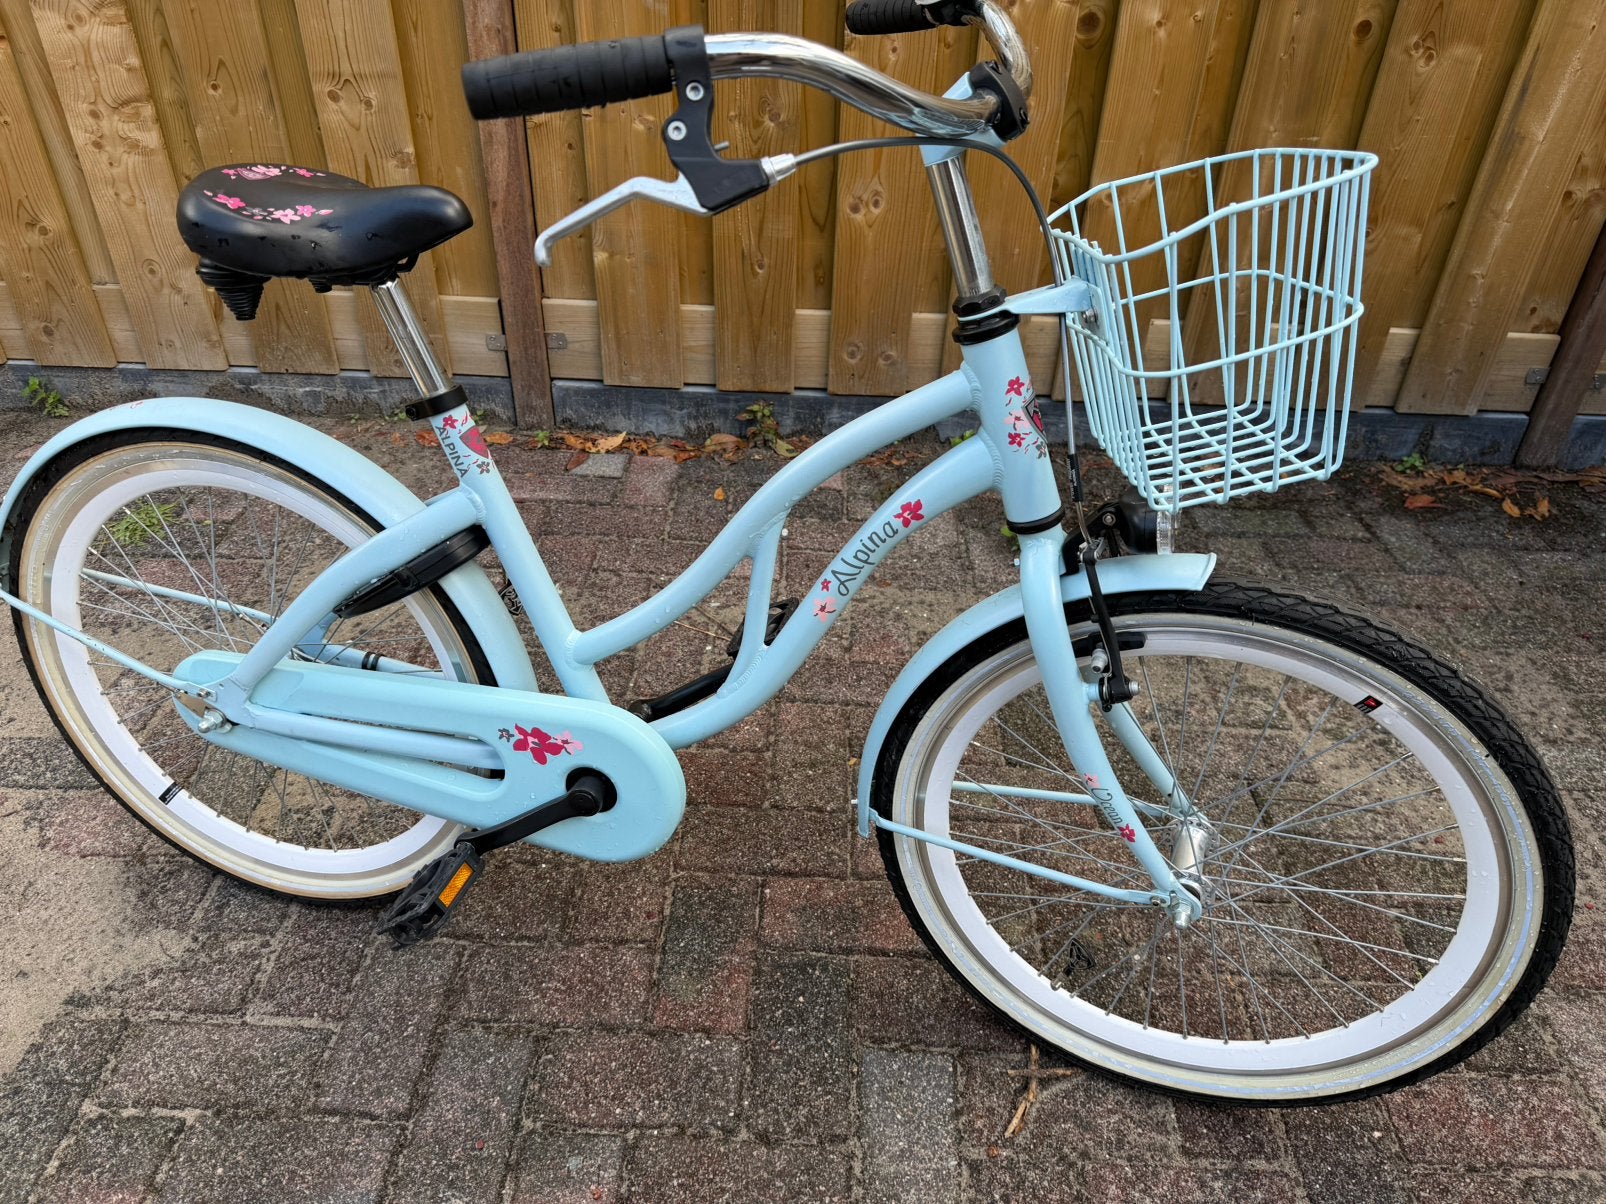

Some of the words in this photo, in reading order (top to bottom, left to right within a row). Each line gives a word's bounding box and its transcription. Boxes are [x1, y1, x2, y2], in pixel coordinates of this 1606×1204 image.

[435, 425, 468, 478] ALPINA
[831, 520, 899, 596] Alpina
[1090, 787, 1123, 826] Ocean
